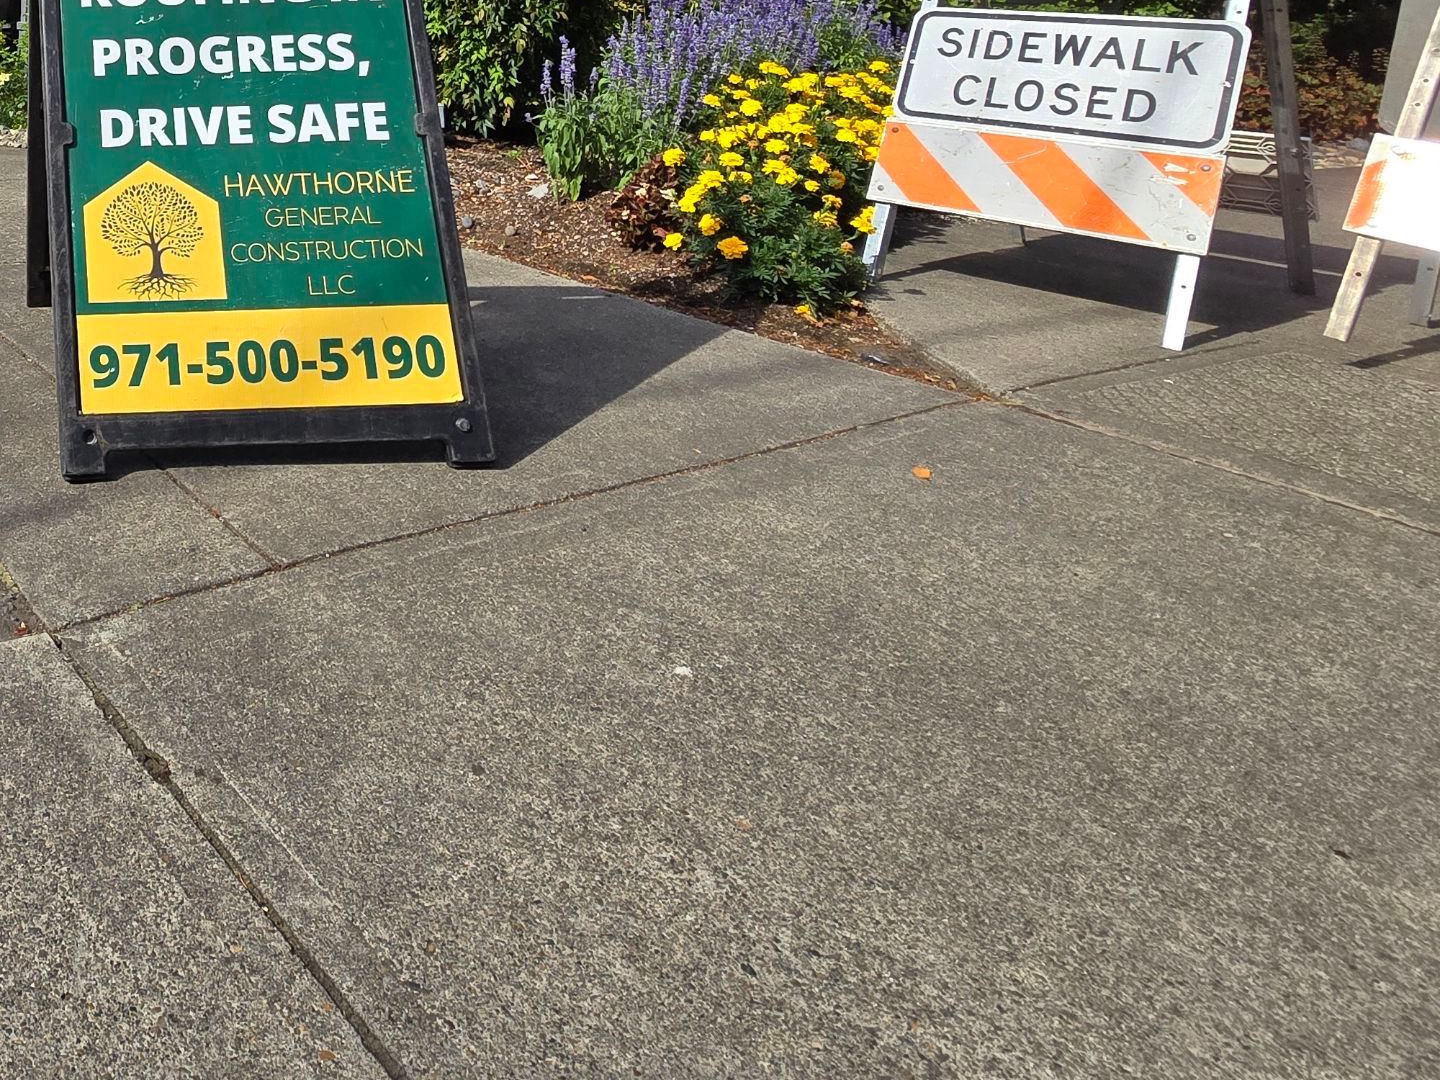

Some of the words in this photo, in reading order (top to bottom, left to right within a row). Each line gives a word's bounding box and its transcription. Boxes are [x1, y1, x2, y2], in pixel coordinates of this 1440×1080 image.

[92, 33, 370, 77] PROGRESS,
[937, 27, 1204, 76] SIDEWALK
[953, 74, 1157, 123] CLOSED
[99, 105, 254, 148] DRIVE
[267, 102, 390, 143] SAFE
[224, 170, 416, 198] HAWTHORNE
[265, 206, 383, 228] GENERAL
[231, 238, 424, 263] CONSTRUCTION
[308, 274, 356, 296] LLC
[89, 334, 446, 389] 971-500-5190
